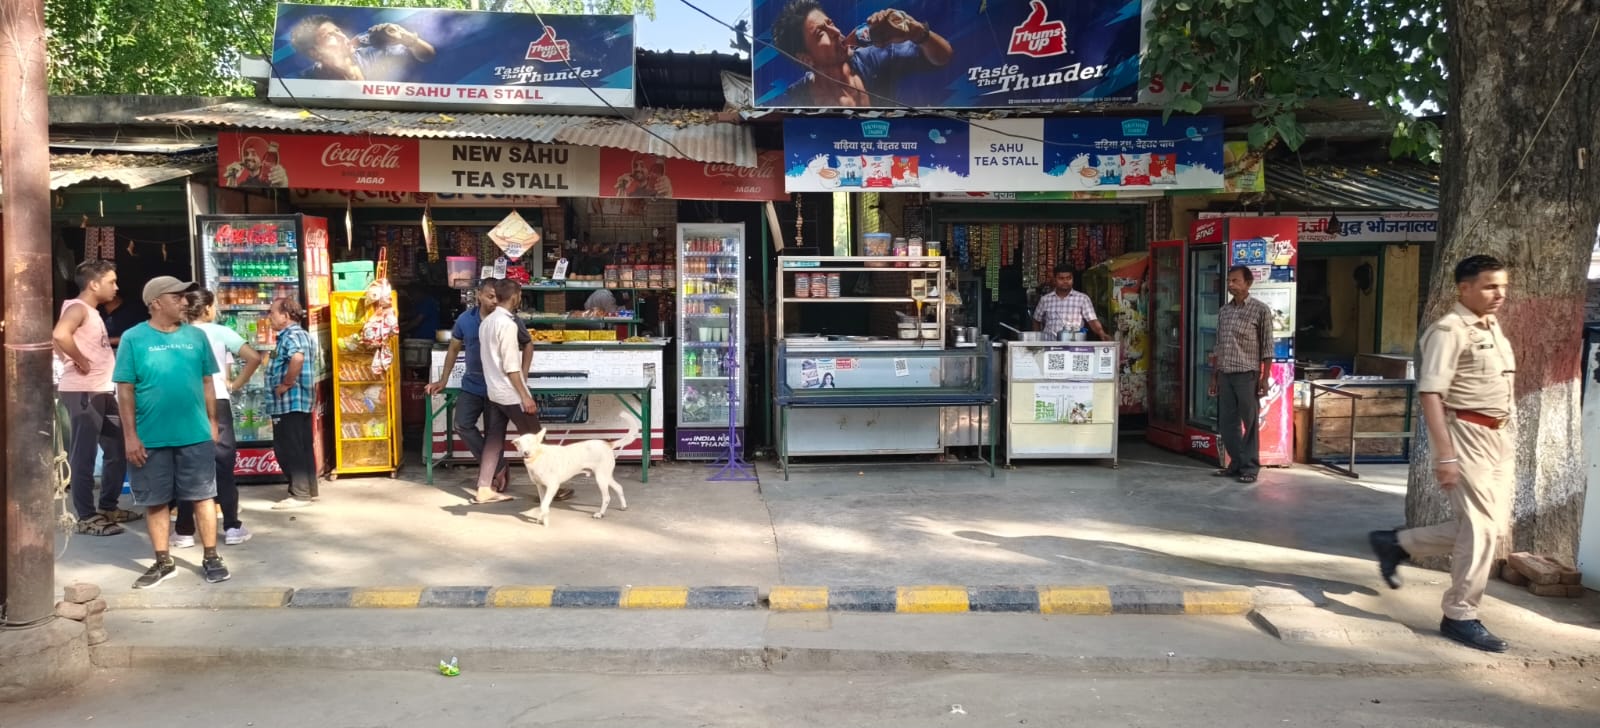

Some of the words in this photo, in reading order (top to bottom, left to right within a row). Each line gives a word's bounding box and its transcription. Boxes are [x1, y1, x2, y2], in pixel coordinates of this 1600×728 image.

[1015, 27, 1061, 45] Thums
[494, 65, 535, 76] Taste
[517, 66, 602, 84] Thunder
[968, 63, 1019, 81] Taste
[977, 77, 997, 87] The
[998, 62, 1109, 92] Thunder
[362, 84, 400, 96] NEW
[405, 86, 451, 98] SAHU
[456, 87, 489, 99] TEA
[494, 89, 544, 100] STALL
[876, 139, 900, 151] बेहतर
[901, 141, 918, 150] चाय
[990, 143, 1024, 153] SAHU
[321, 142, 404, 168] Coca-Cola
[452, 145, 501, 162] NEW
[509, 145, 569, 164] SAHU
[974, 156, 999, 166] TEA
[1001, 156, 1039, 166] STALL
[452, 170, 496, 187] TEA
[502, 172, 568, 190] STALL
[1366, 217, 1440, 233] भोजनालय
[1191, 440, 1211, 449] STING
